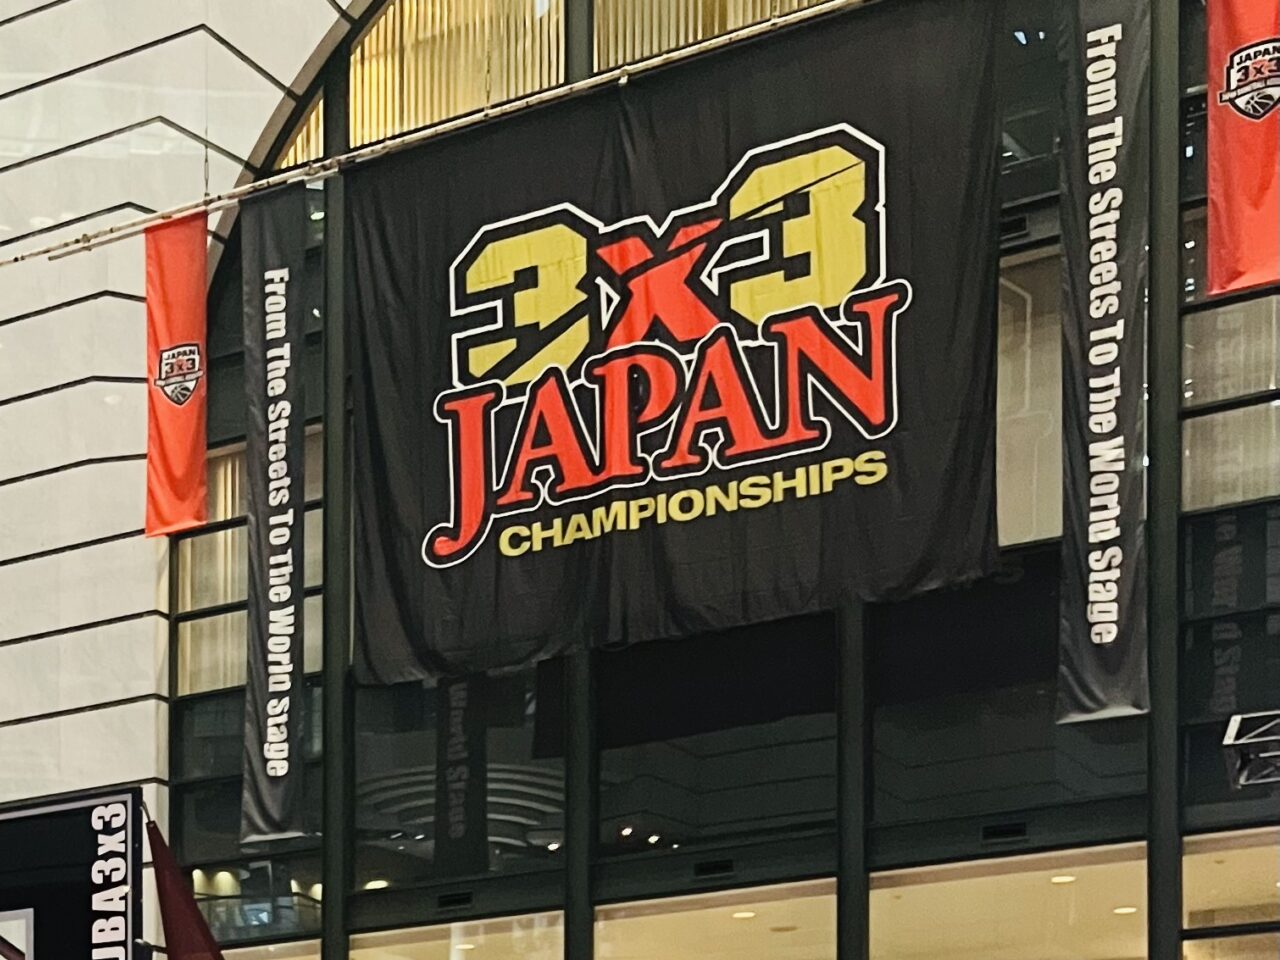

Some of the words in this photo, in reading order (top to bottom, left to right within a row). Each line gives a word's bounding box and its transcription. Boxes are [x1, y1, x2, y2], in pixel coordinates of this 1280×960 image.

[1086, 23, 1123, 116] From
[1088, 116, 1123, 186] The
[1088, 187, 1123, 319] Streets
[264, 267, 290, 341] From
[1088, 319, 1125, 366] To
[164, 348, 197, 361] JAPAN
[266, 342, 291, 398] The
[431, 290, 902, 560] JAPAN
[1088, 366, 1122, 434] The
[267, 400, 292, 507] Streets
[1088, 435, 1126, 544] World
[269, 508, 295, 546] To
[497, 449, 888, 557] CHAMPIONSHIPS
[269, 547, 294, 603] The
[1086, 545, 1123, 645] Stage
[267, 605, 296, 692] World
[263, 696, 290, 777] Stage
